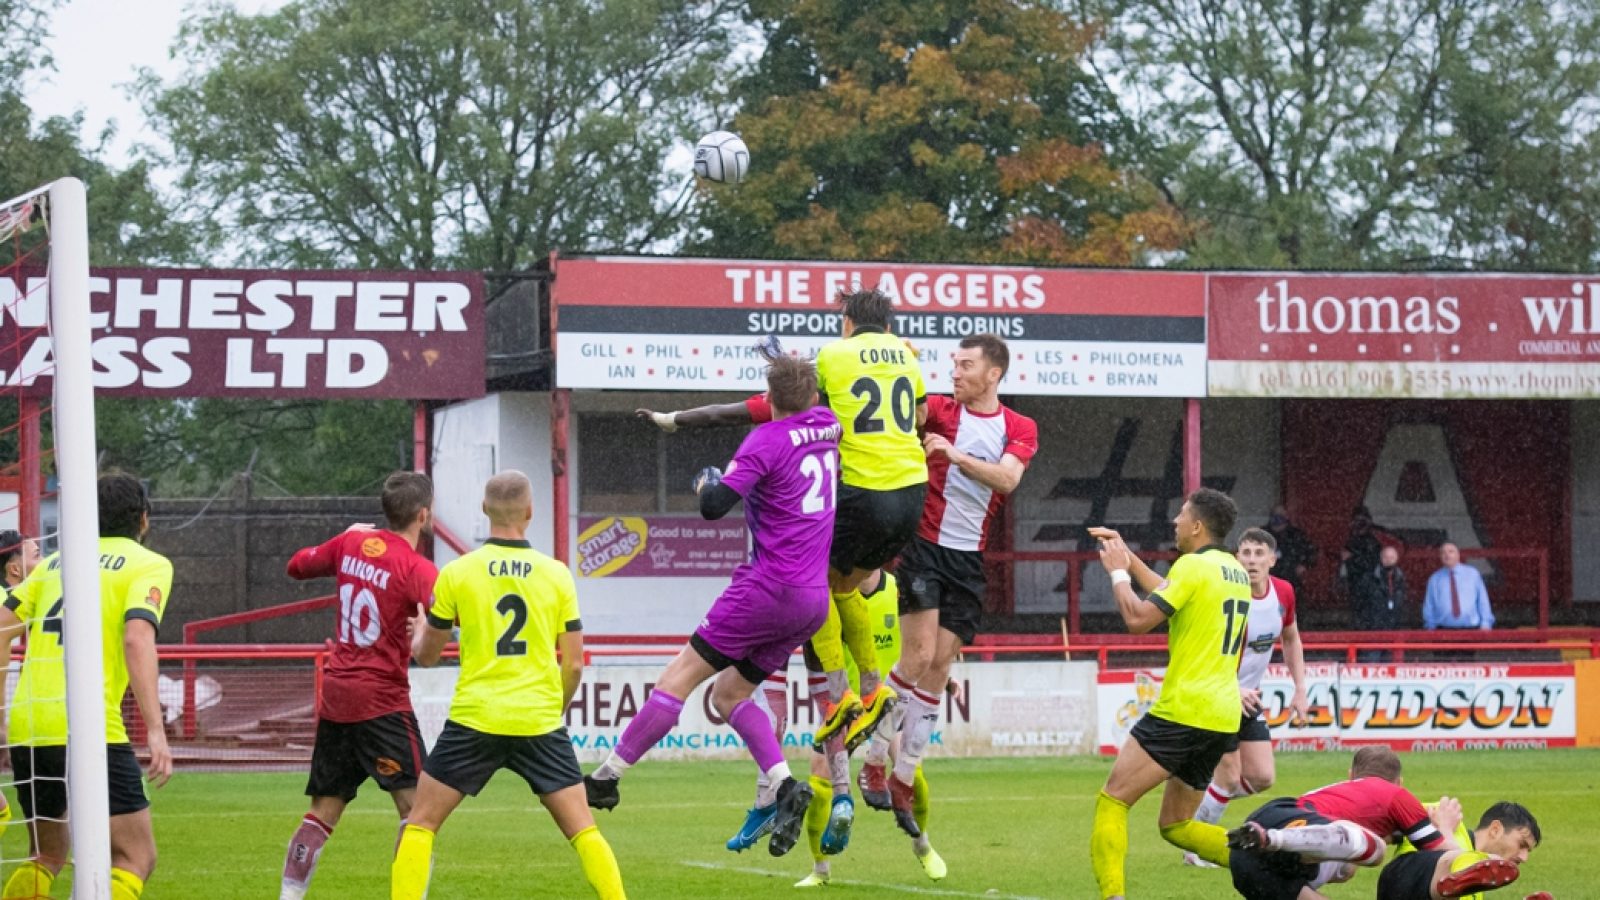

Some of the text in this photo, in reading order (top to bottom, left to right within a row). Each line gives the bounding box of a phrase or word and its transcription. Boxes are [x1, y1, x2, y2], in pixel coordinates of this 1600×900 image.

[725, 269, 811, 304] THE
[1256, 280, 1461, 334] thomas
[747, 313, 843, 333] SUPPOR
[894, 315, 1024, 337] THE ROBINS
[0, 336, 389, 388] ASS LTD
[581, 342, 617, 358] GILL
[645, 344, 682, 358] PHIL
[859, 348, 905, 365] COOKE
[1035, 351, 1063, 365] LES
[1090, 351, 1184, 366] PHILOMENA
[608, 365, 635, 378] IAN
[666, 366, 707, 380] PAUL
[1037, 372, 1158, 386] NOEL BRYAN
[1301, 368, 1349, 388] 0161
[850, 376, 916, 434] 20
[800, 450, 836, 514] 21
[579, 519, 627, 556] smart
[649, 526, 744, 541] Good to see you!
[580, 532, 641, 577] storage
[488, 560, 532, 578] CAMP
[339, 582, 381, 647] 10
[496, 593, 528, 656] 2
[1222, 598, 1250, 655] 17
[1395, 667, 1487, 679] SUPPORTED
[1491, 667, 1509, 679] BY
[1260, 682, 1565, 730] DAVIDSON
